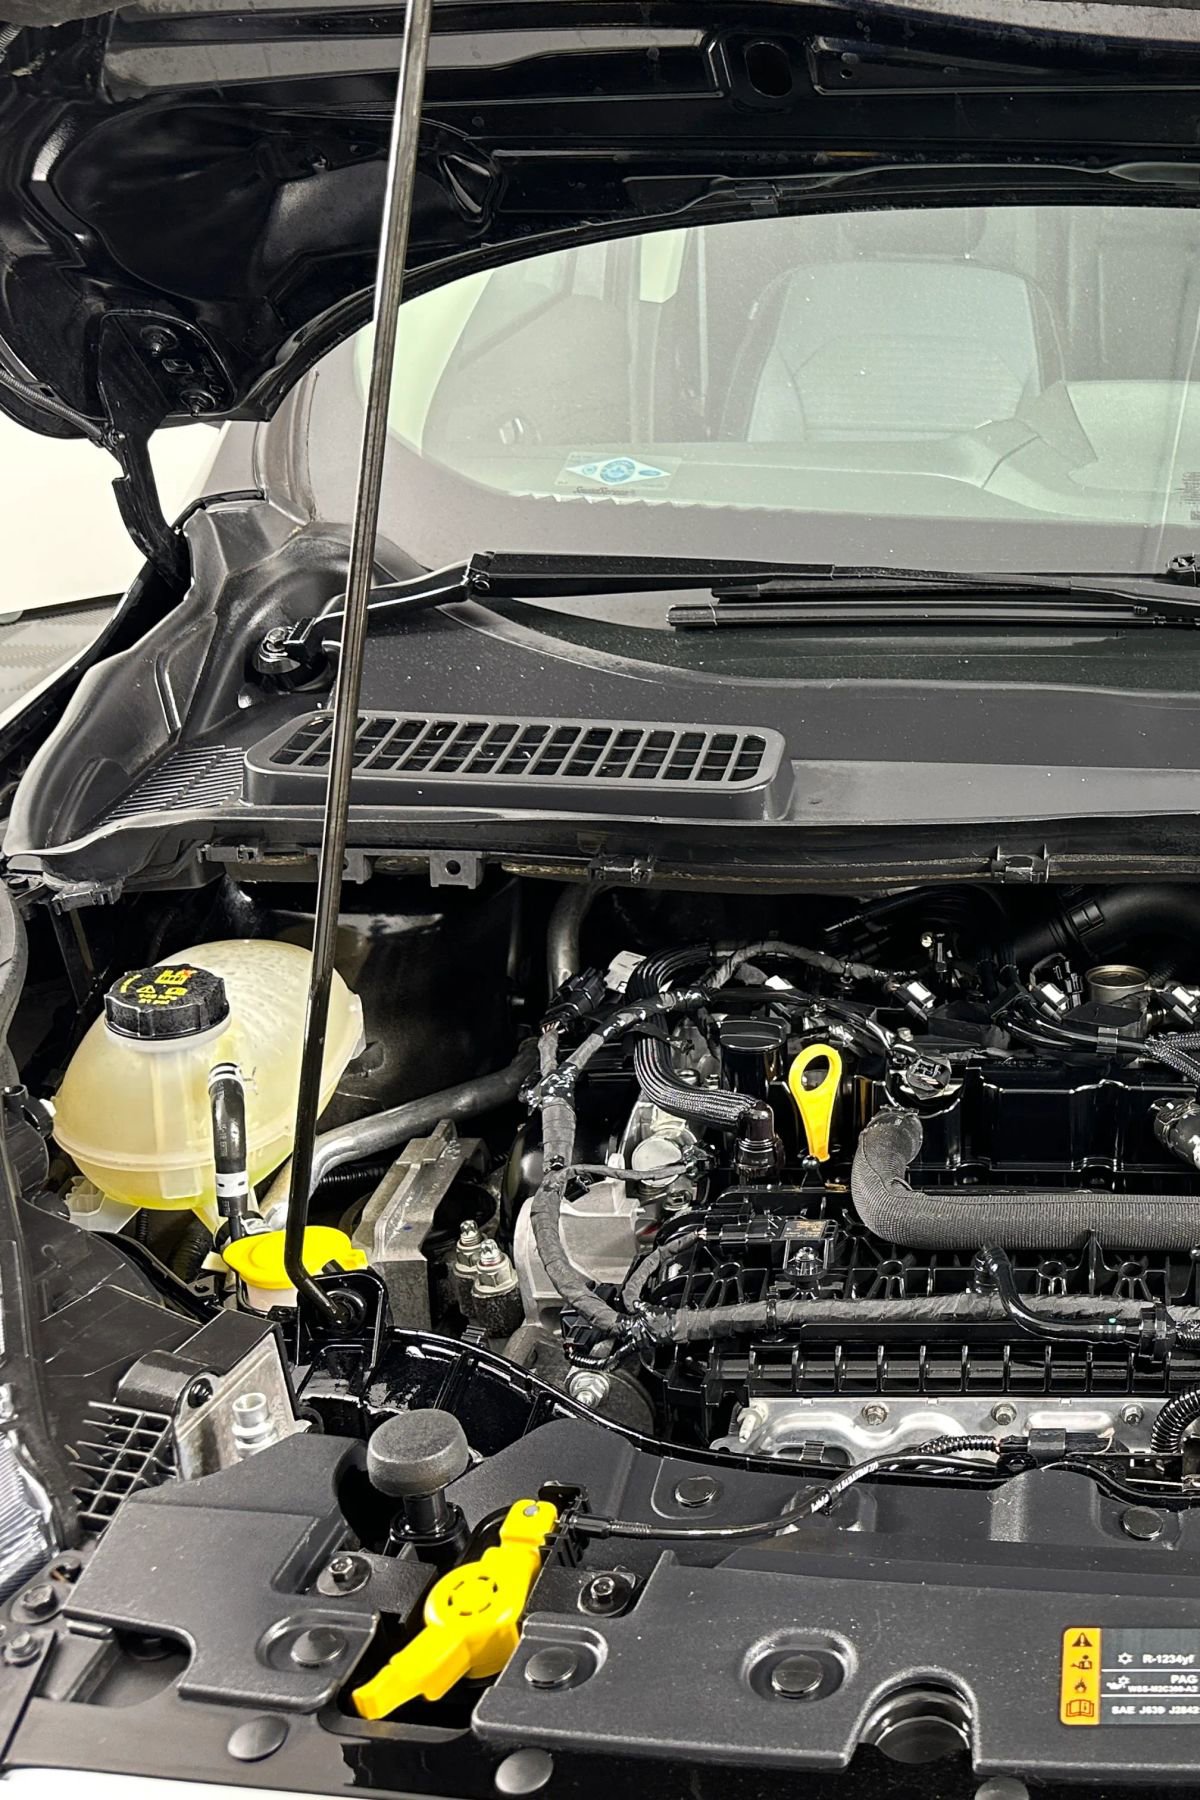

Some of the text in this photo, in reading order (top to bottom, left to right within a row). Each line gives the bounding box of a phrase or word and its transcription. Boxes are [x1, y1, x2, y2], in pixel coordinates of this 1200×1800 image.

[1142, 1654, 1196, 1666] R-1234yf
[1170, 1674, 1199, 1684] PAG
[1111, 1705, 1136, 1714] SAE
